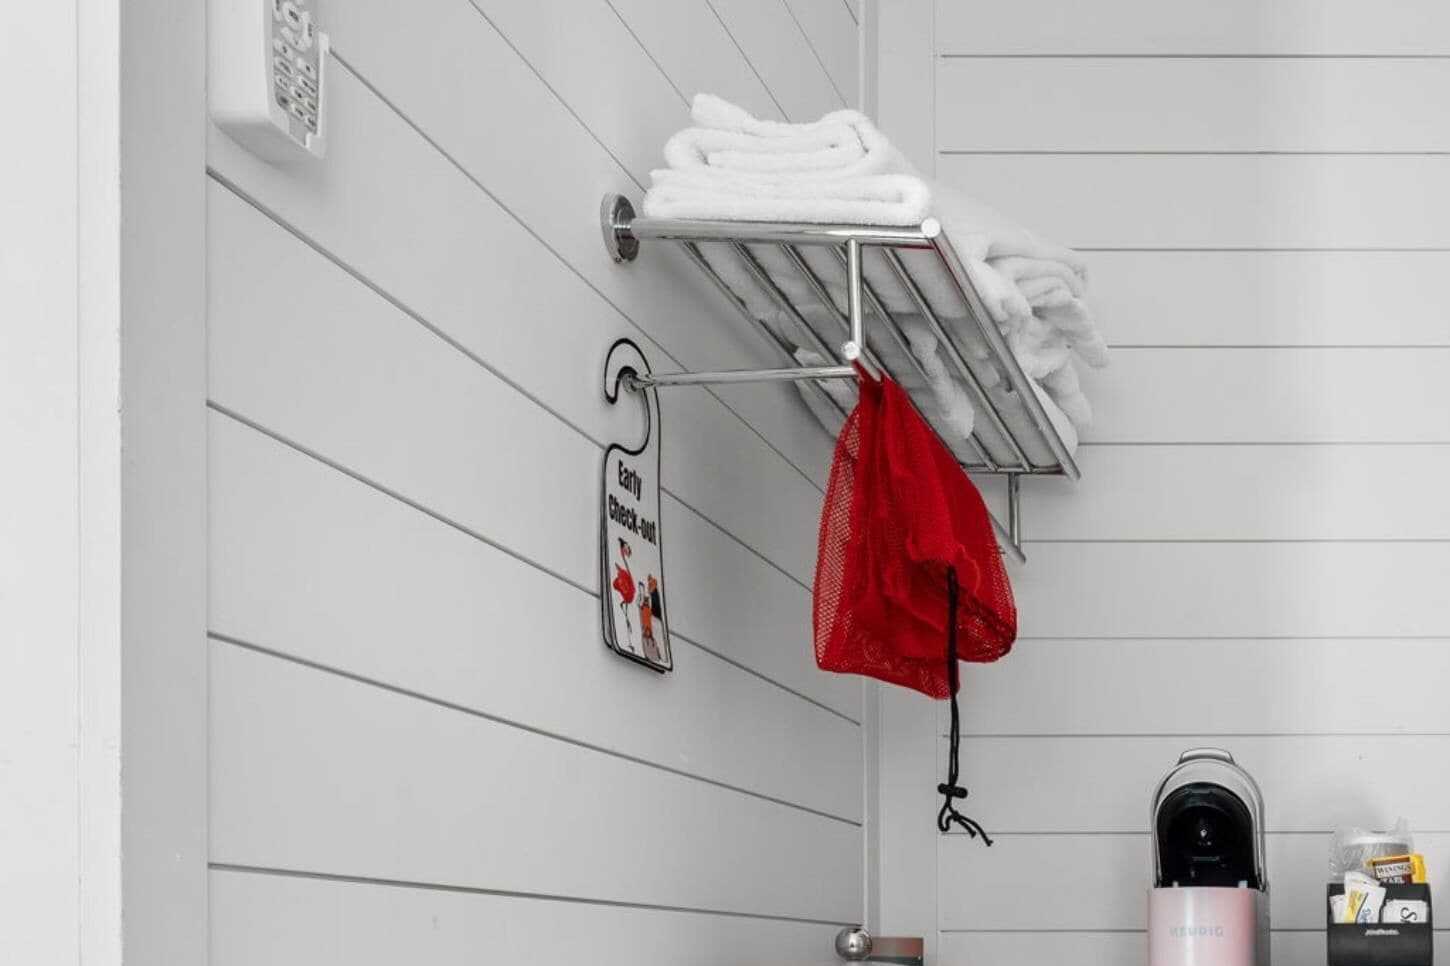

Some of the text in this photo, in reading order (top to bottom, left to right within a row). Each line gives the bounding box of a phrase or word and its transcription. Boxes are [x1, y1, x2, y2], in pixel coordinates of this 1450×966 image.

[618, 459, 642, 501] Early
[608, 493, 657, 546] Check-out
[1169, 926, 1224, 937] KEURIG
